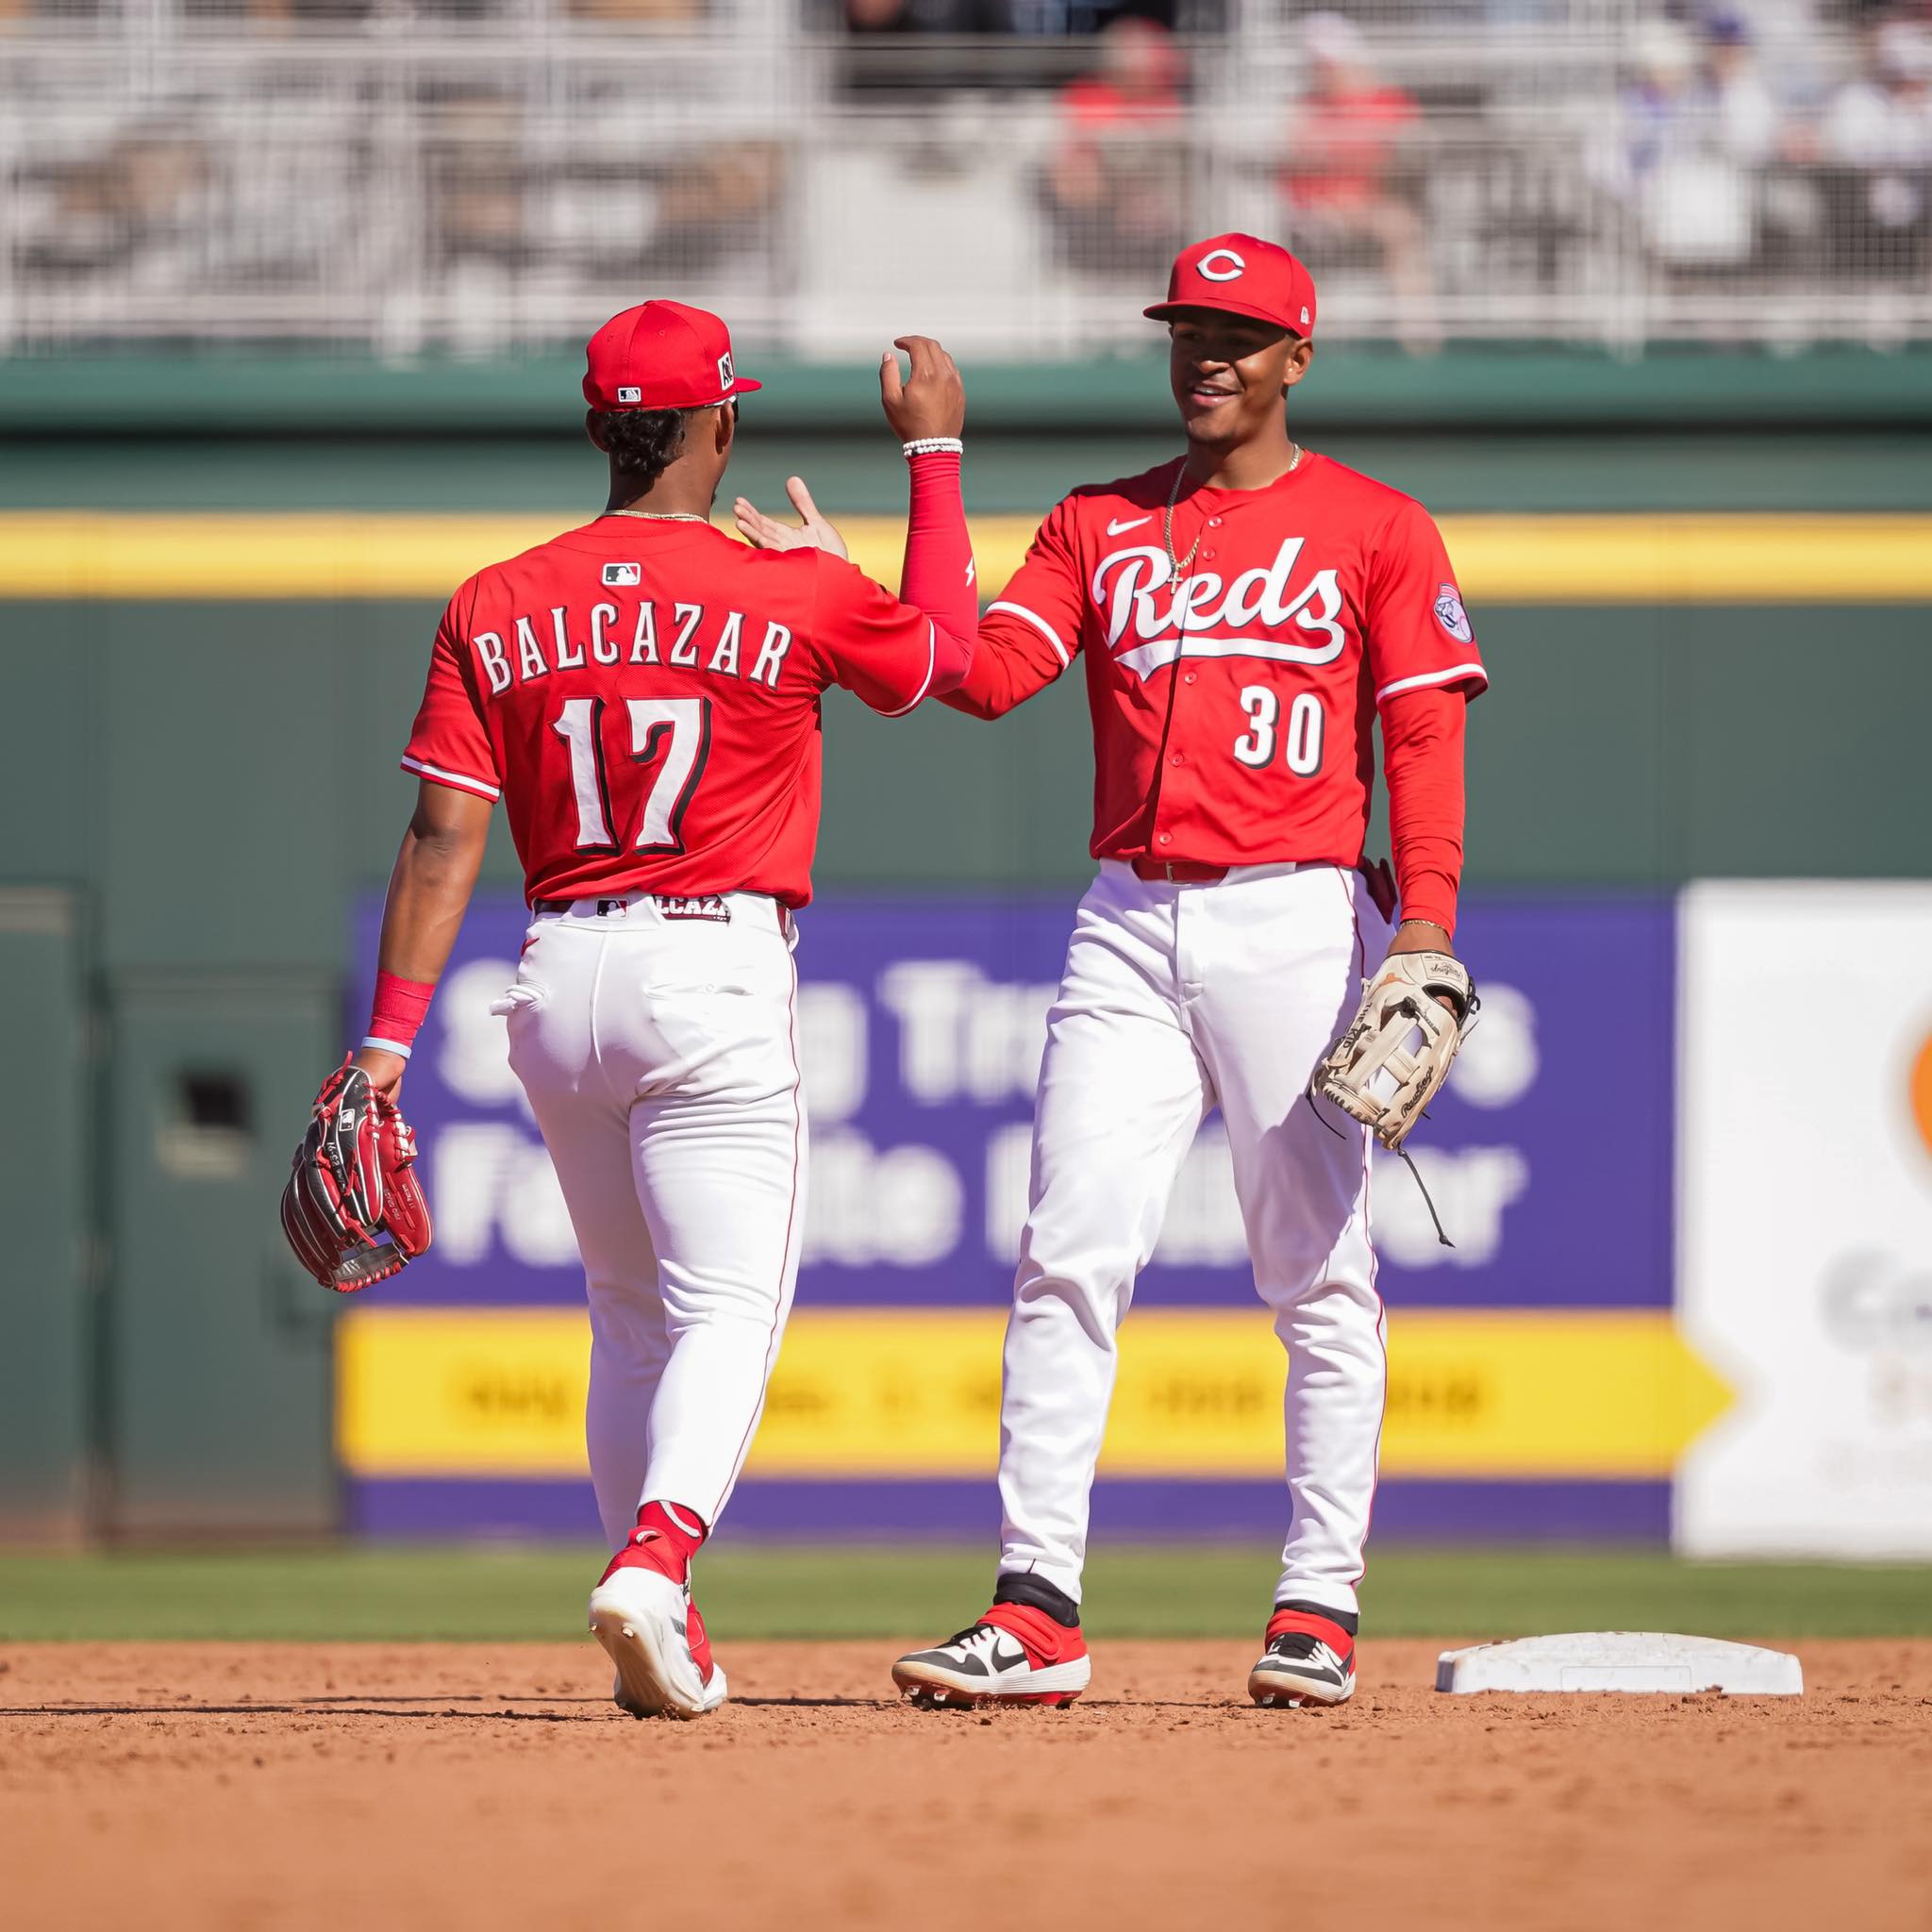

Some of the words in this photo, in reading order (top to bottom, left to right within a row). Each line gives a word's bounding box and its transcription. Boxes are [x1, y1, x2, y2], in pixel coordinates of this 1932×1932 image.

[1196, 248, 1245, 283] C
[473, 601, 793, 696] BALCAZAR
[1091, 536, 1346, 683] Reds
[551, 695, 712, 857] 17
[1233, 685, 1324, 777] 30
[1342, 1028, 1359, 1048] KID
